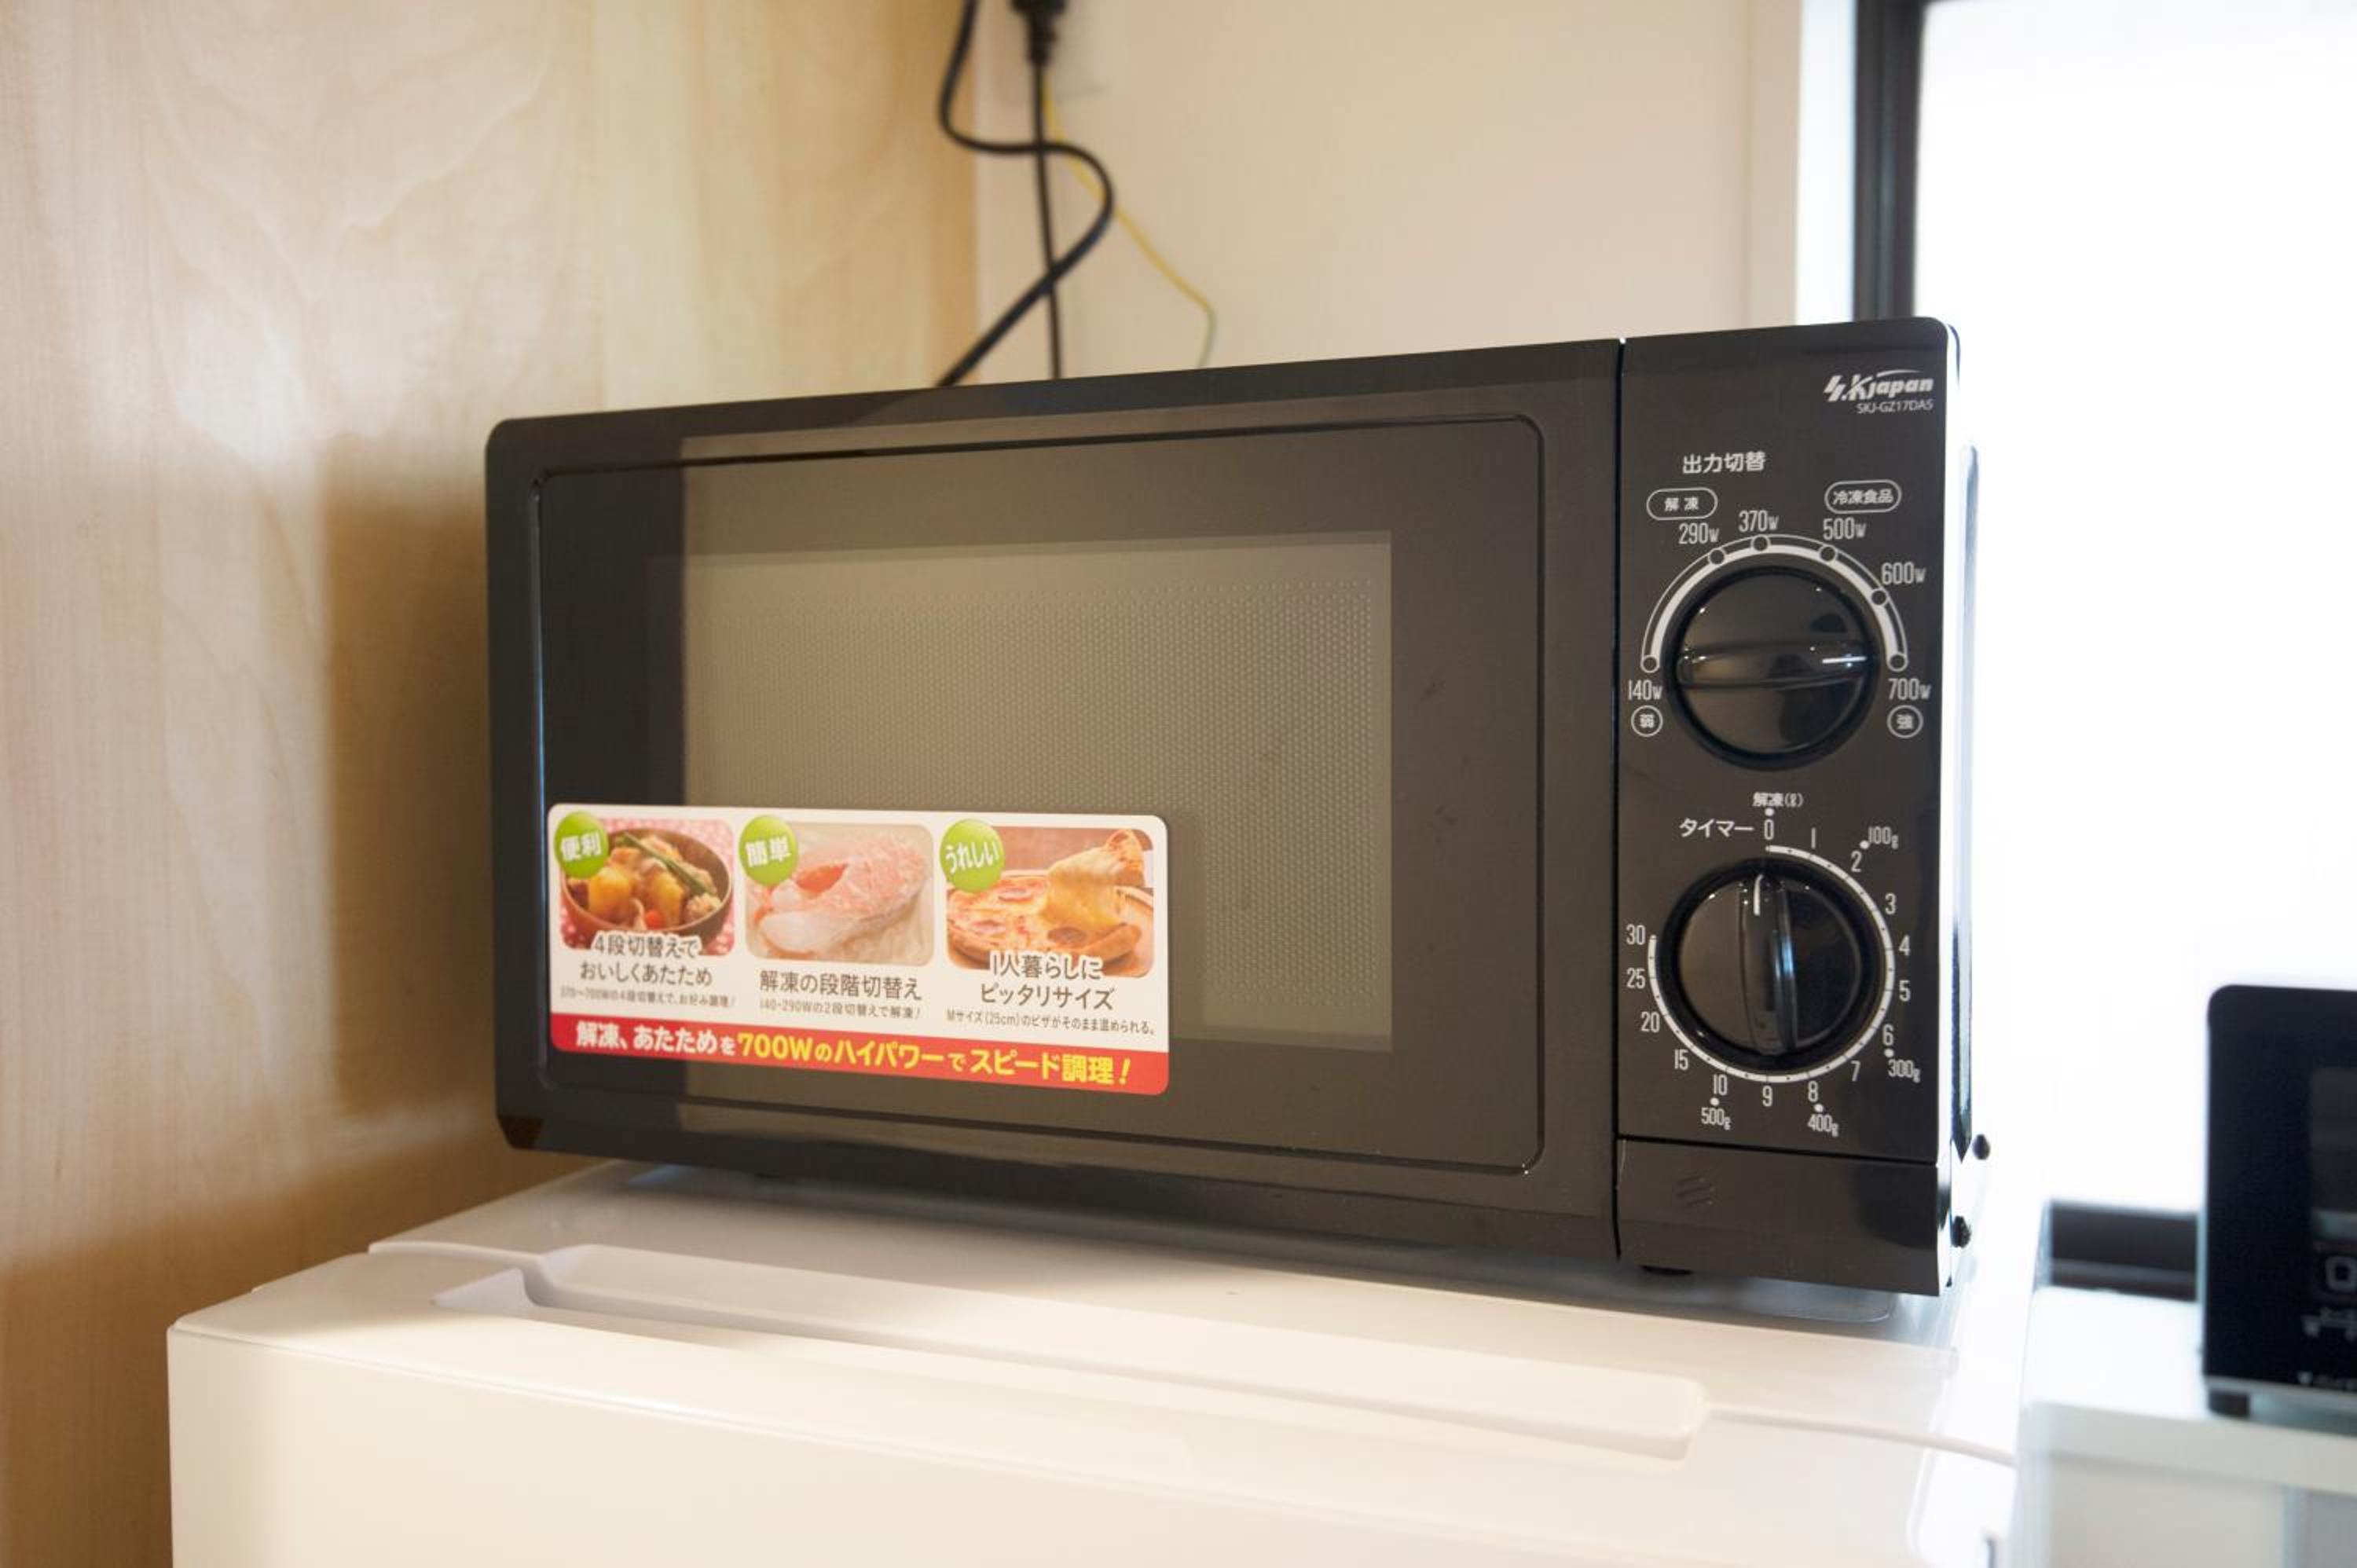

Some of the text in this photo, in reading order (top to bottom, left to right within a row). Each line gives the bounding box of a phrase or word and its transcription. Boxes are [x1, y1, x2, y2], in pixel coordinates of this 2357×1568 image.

[1682, 451, 1766, 474] 出力切替
[1663, 496, 1700, 512] 解凍
[1832, 489, 1894, 505] 冷凍食品
[1679, 818, 1754, 838] タイマー
[1764, 819, 1775, 841] 0
[1867, 826, 1899, 849] 100g
[560, 833, 603, 862] 便利
[745, 837, 792, 867] 簡単
[944, 841, 1000, 874] うれしい
[1850, 852, 1863, 873] 2
[1885, 893, 1897, 914] 3
[1626, 924, 1647, 945] 30
[1898, 935, 1911, 956] 4
[595, 933, 698, 959] 4段切替えで
[579, 959, 713, 987] おいしくあたため
[992, 953, 1102, 980] 1人暮らしに
[759, 969, 922, 1001] 解凍の段階切替え
[1626, 967, 1647, 989] 25
[981, 982, 1115, 1010] ピッタリサイズ
[1898, 980, 1911, 1002] 5
[1640, 1011, 1661, 1033] 20
[1882, 1024, 1894, 1046] 6
[1674, 1049, 1689, 1071] 15
[1888, 1059, 1921, 1083] 300g
[1850, 1061, 1862, 1082] 7
[1713, 1075, 1728, 1095] 10
[1808, 1081, 1819, 1102] 8
[1762, 1086, 1773, 1107] 9
[1701, 1108, 1731, 1130] 500g
[1807, 1113, 1839, 1137] 400g
